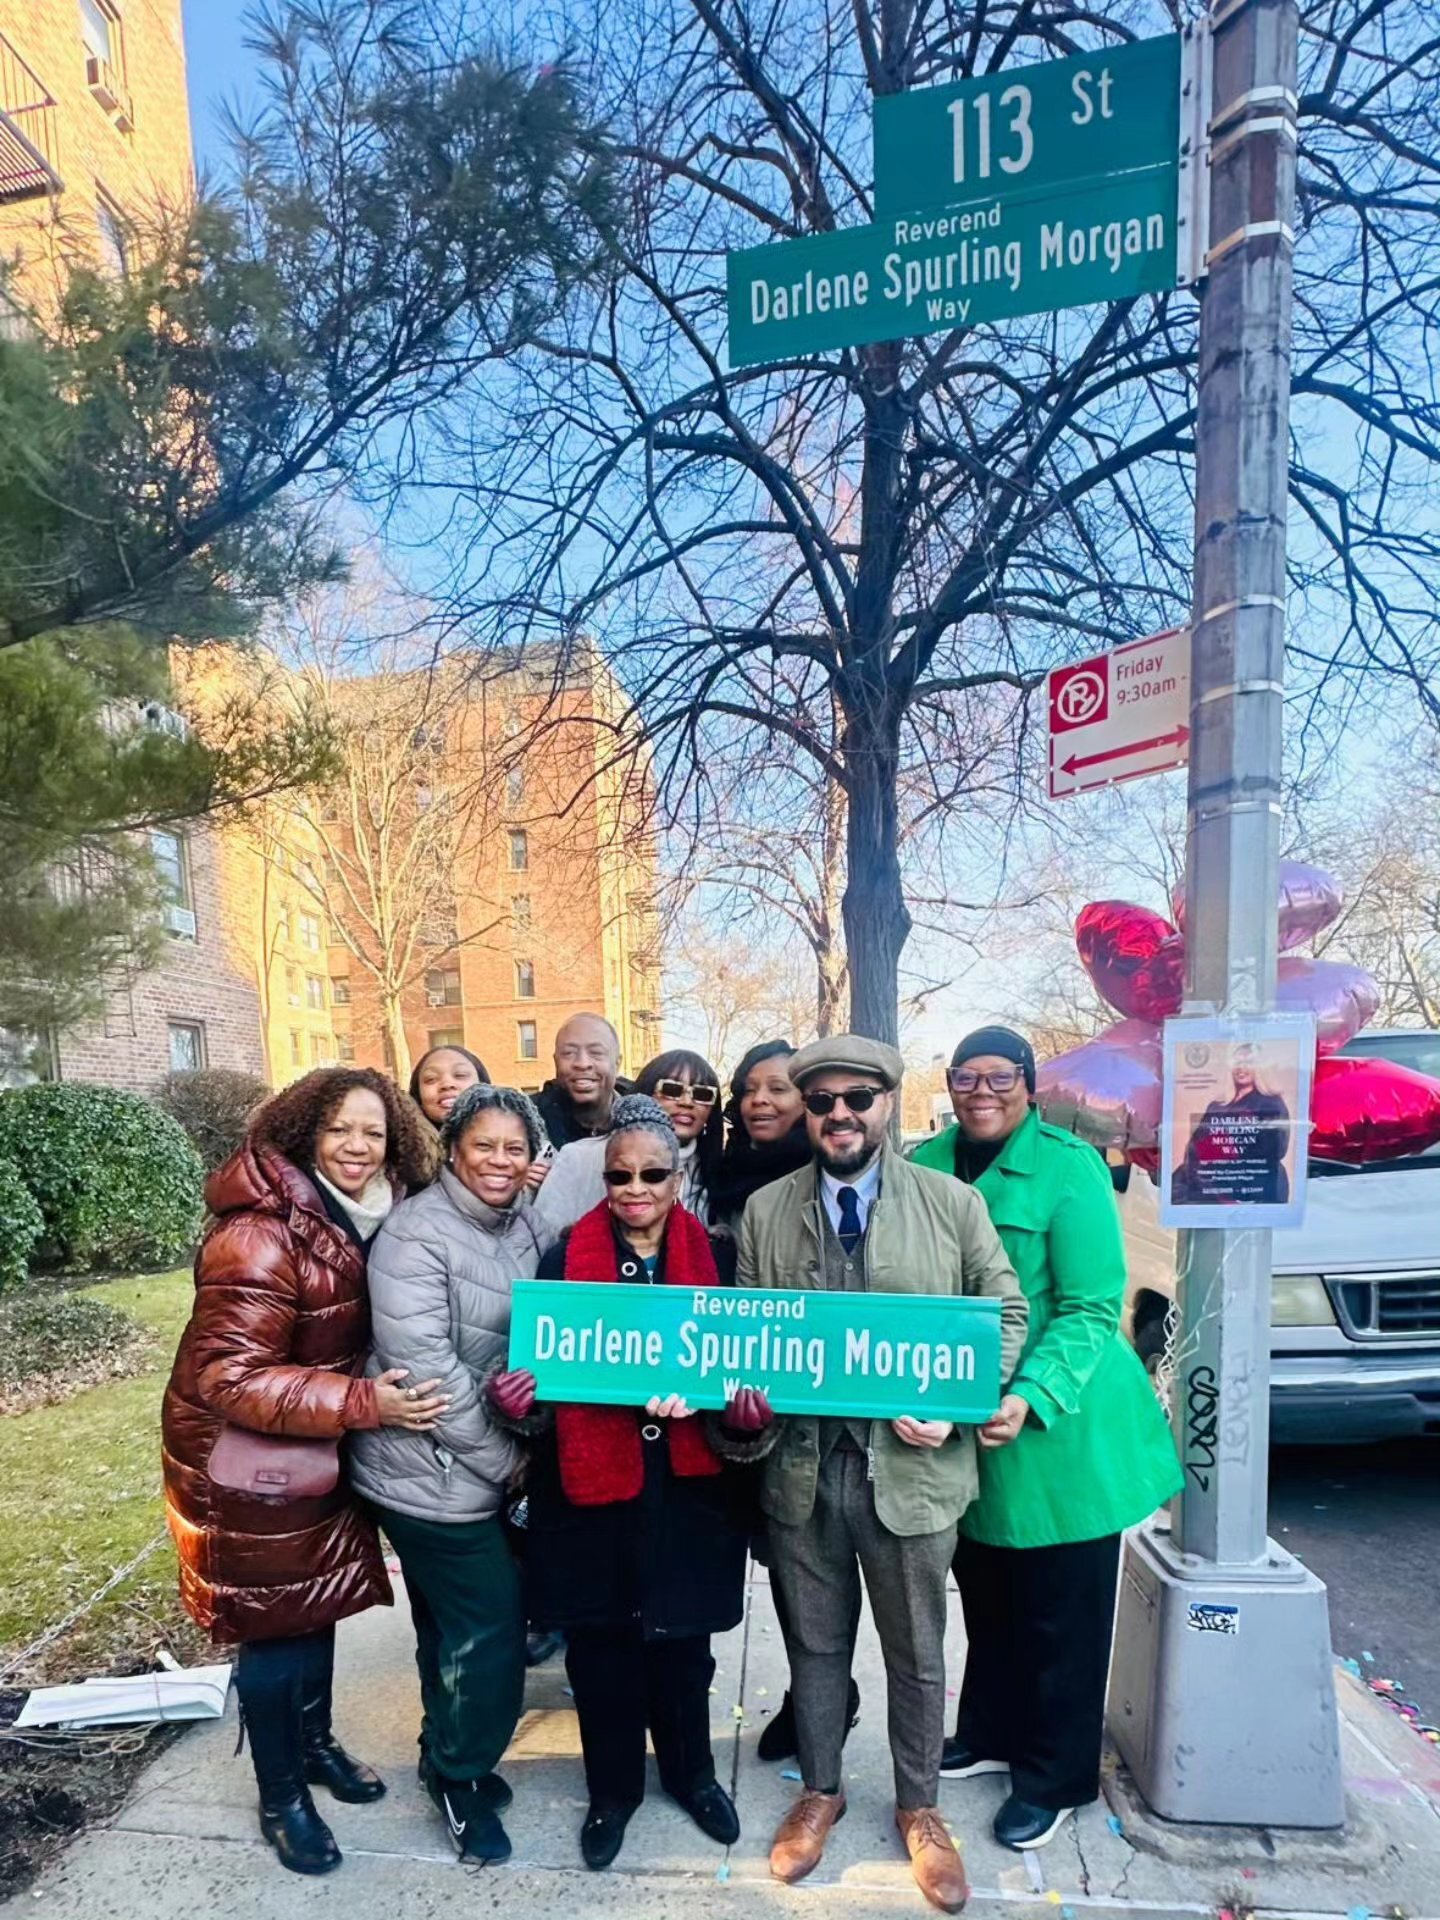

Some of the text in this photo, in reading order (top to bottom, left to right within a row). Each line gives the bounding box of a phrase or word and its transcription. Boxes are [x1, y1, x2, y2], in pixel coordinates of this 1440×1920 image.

[947, 68, 1114, 183] 113 St
[895, 202, 1001, 245] Reverend
[751, 213, 1164, 324] Darlene Spurling Morgan
[927, 298, 971, 322] Way
[1116, 655, 1164, 681] Friday
[1116, 676, 1177, 706] 9:30am
[1209, 1126, 1260, 1135] SPURLING
[1210, 1116, 1259, 1125] DARLENE
[1211, 1136, 1257, 1145] MORGAN
[1221, 1146, 1247, 1154] WAY
[692, 1290, 806, 1319] Reverend
[535, 1315, 975, 1393] Darlene Spurling Morgan
